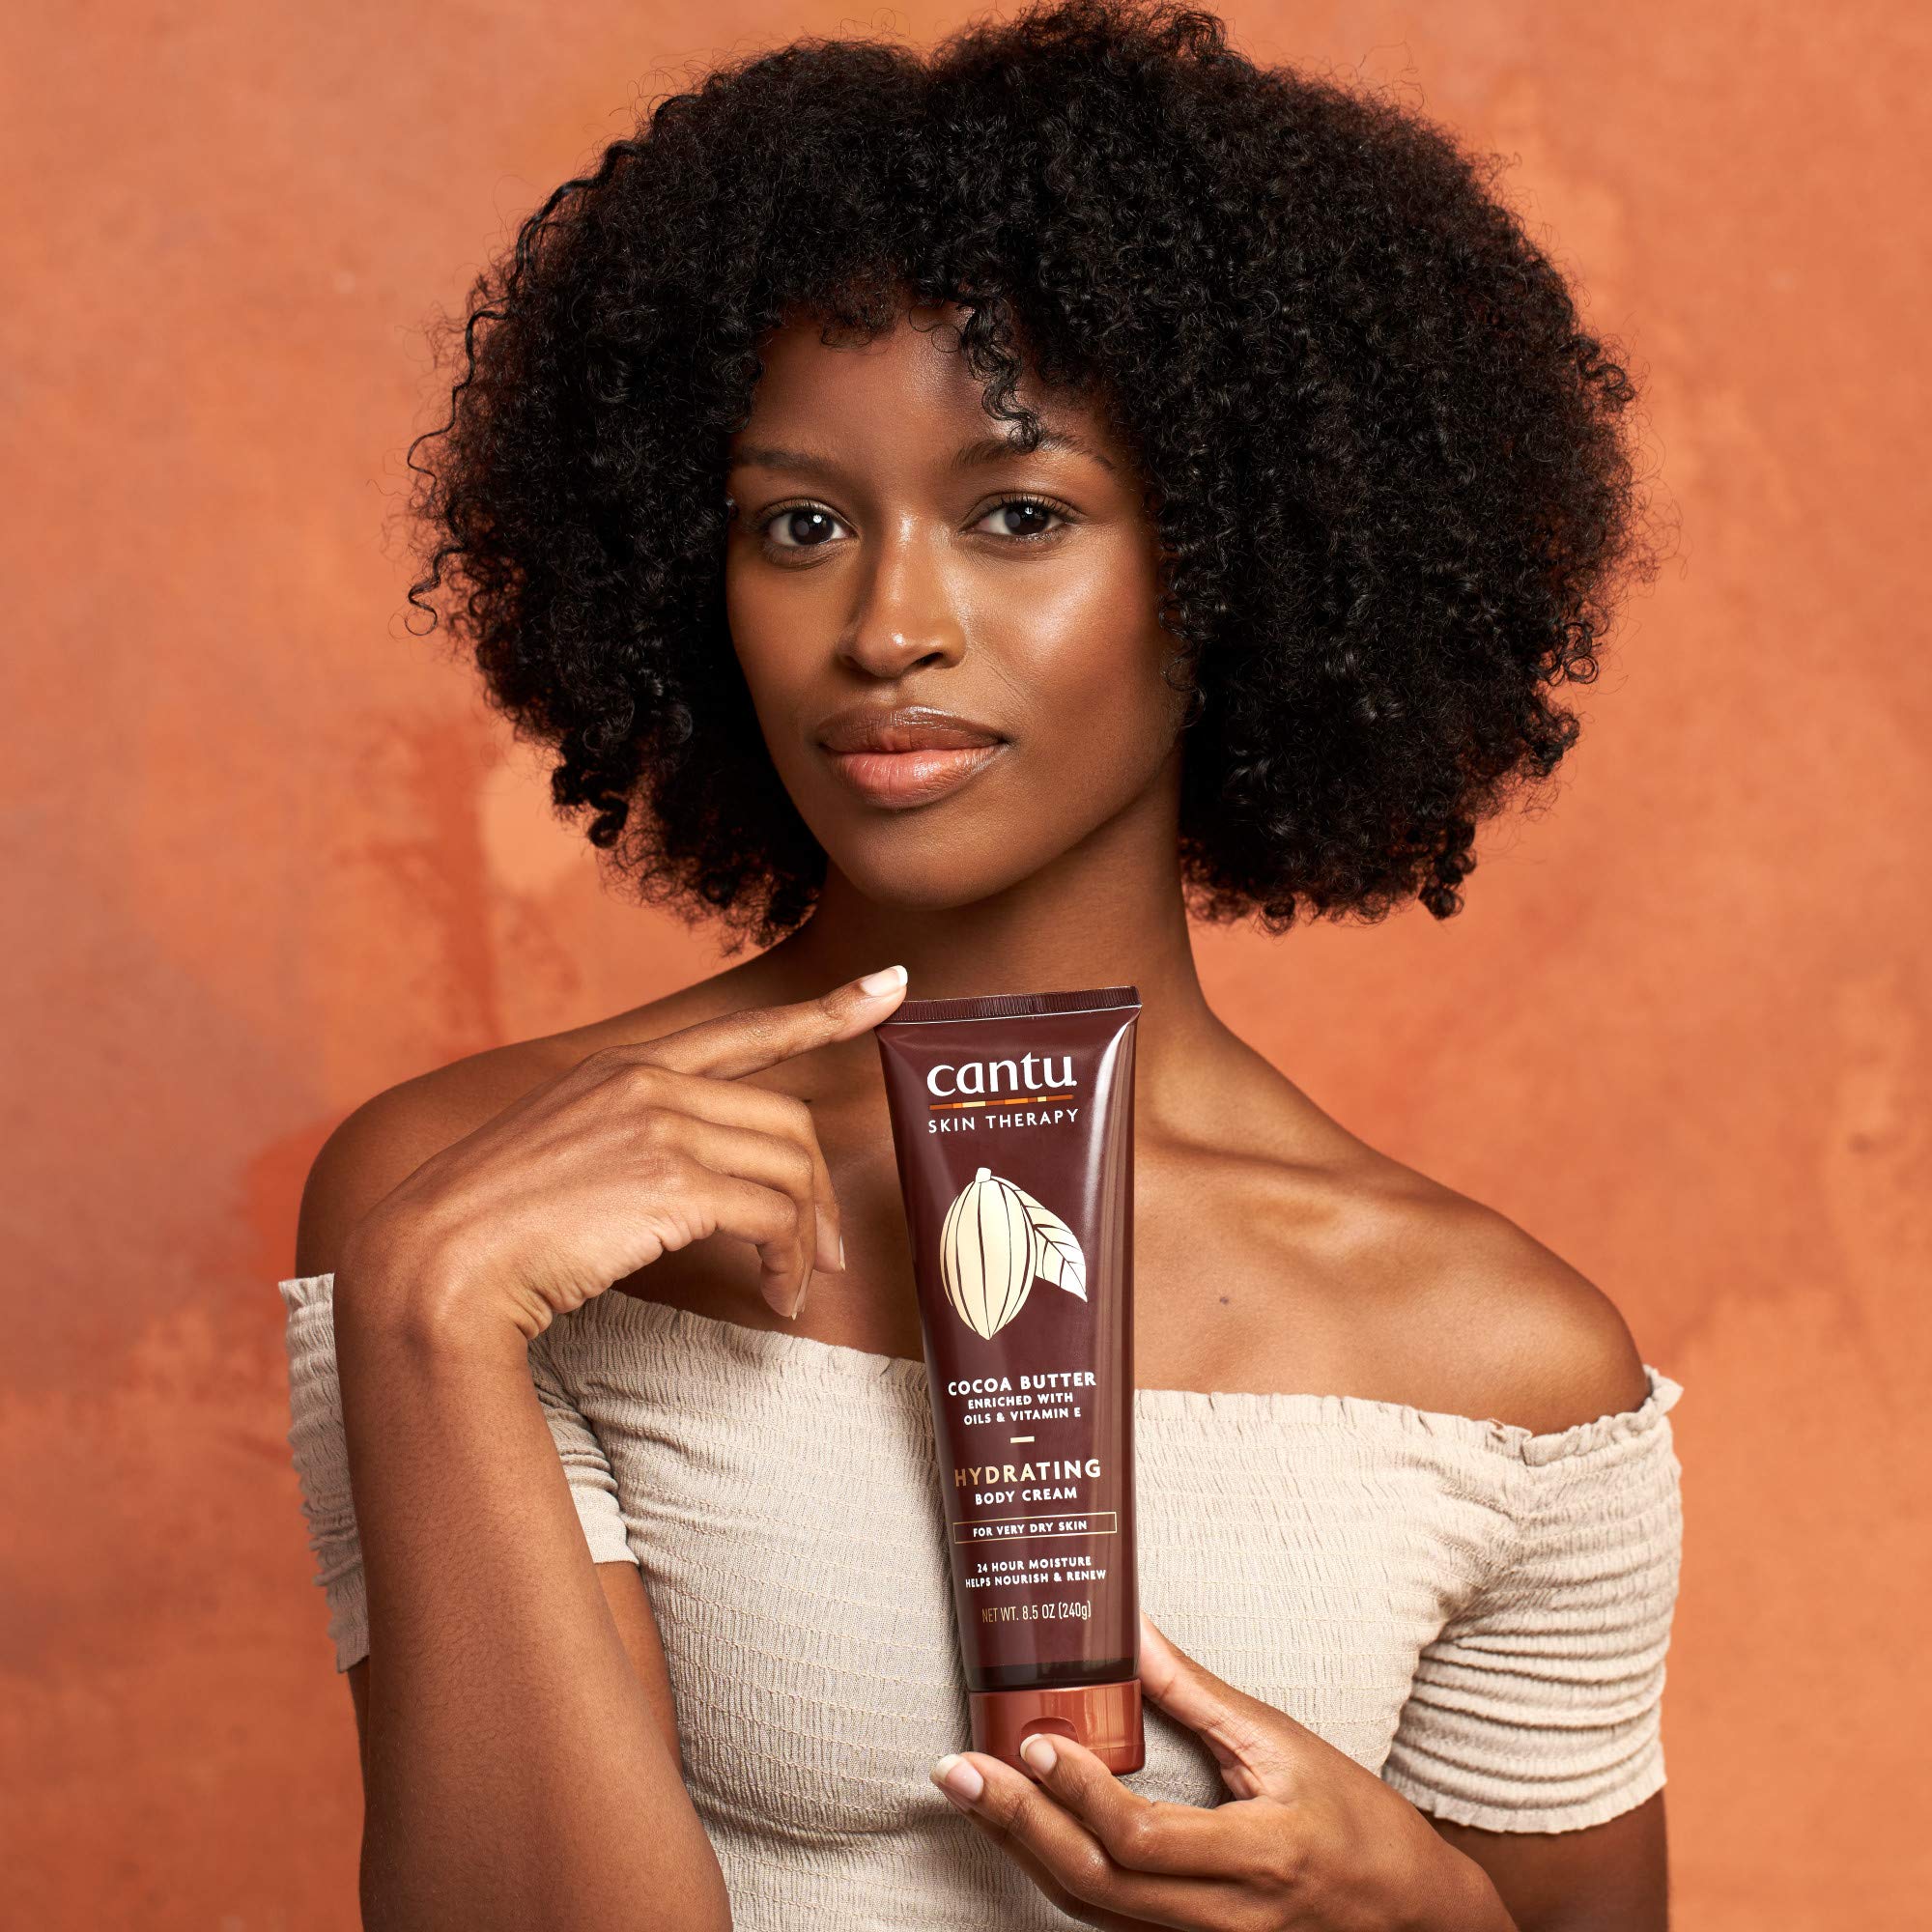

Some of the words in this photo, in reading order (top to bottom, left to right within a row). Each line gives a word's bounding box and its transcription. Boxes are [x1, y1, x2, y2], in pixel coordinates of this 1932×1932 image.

[927, 1052, 1077, 1097] cantu
[928, 1117, 976, 1133] SKIN
[985, 1109, 1079, 1129] THERAPY
[948, 1378, 1012, 1396] COCOA
[1020, 1372, 1096, 1390] BUTTER
[968, 1395, 1032, 1409] ENRICHED
[1037, 1392, 1073, 1404] WITH
[964, 1413, 991, 1426] OILS
[996, 1412, 1006, 1423] &
[1010, 1408, 1069, 1421] VITAMIN
[1074, 1407, 1081, 1417] E
[954, 1459, 1101, 1488] HYDRATING
[975, 1491, 1015, 1505] BODY
[1022, 1487, 1077, 1501] CREAM
[973, 1527, 993, 1538] FOR
[996, 1524, 1025, 1535] VERY
[1030, 1522, 1054, 1533] DRY
[1059, 1520, 1087, 1531] SKIN
[977, 1563, 988, 1573] 24
[991, 1560, 1024, 1572] HOUR
[1029, 1556, 1092, 1570] MOISTURE
[965, 1577, 991, 1588] HELPS
[995, 1574, 1049, 1586] NOURISH
[1053, 1573, 1063, 1582] &
[1066, 1570, 1106, 1581] RENEW
[981, 1607, 998, 1623] NET
[1000, 1605, 1019, 1622] WT.
[1022, 1605, 1038, 1620] 8.5
[1042, 1604, 1056, 1619] OZ
[1059, 1600, 1092, 1620] (240g)
